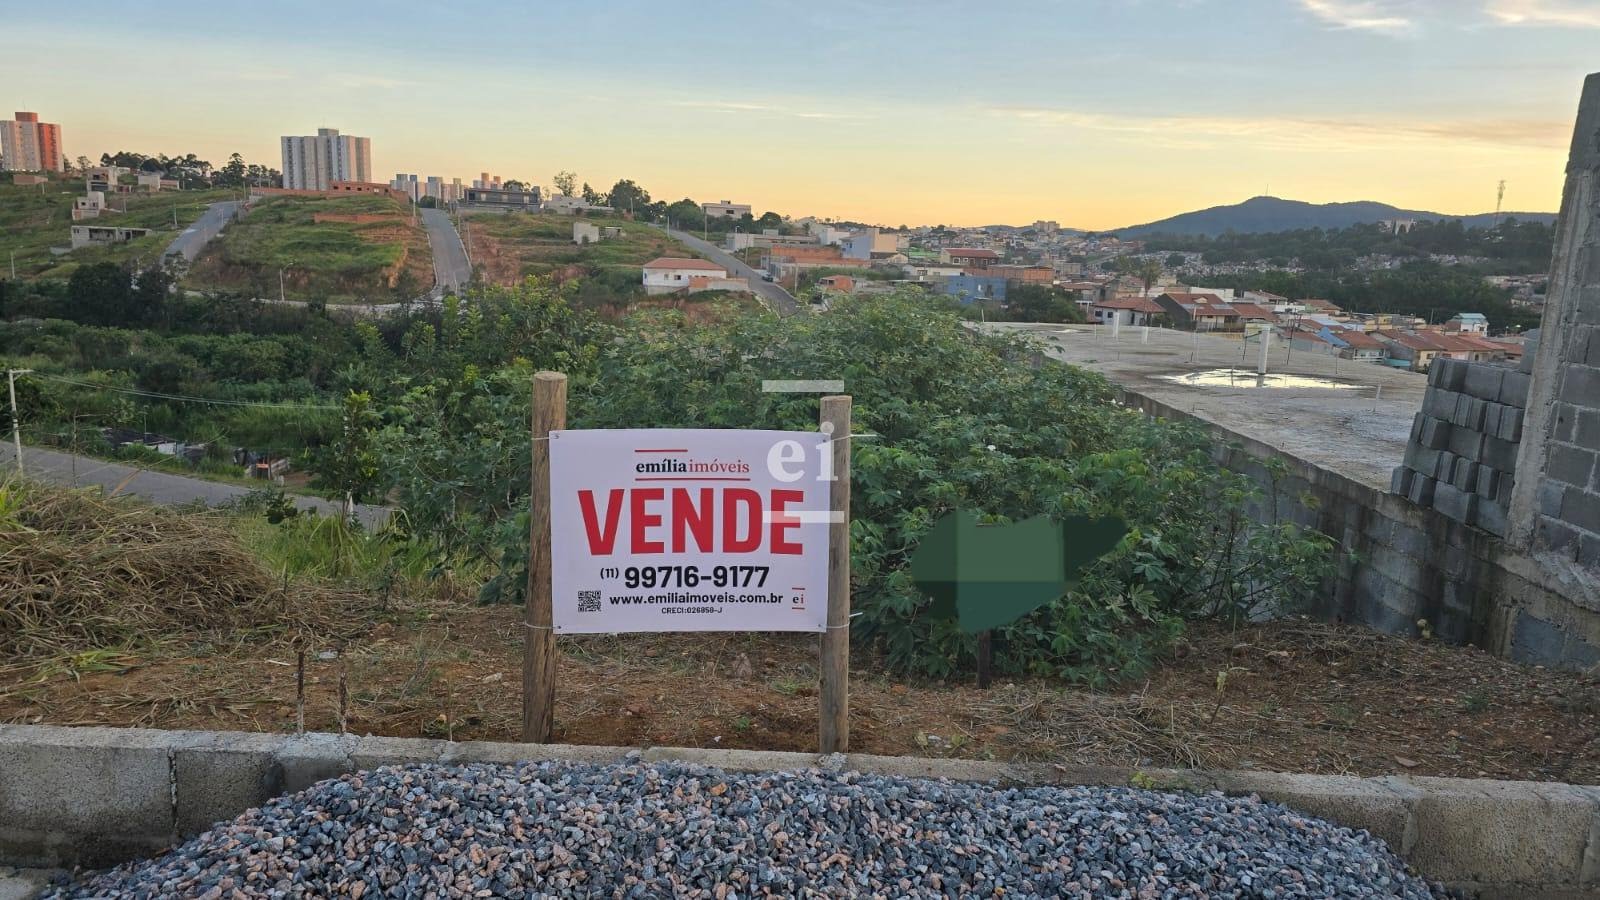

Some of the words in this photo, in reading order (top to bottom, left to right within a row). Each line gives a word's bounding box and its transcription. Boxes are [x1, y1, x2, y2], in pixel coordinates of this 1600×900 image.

[635, 458, 687, 473] emília
[688, 458, 750, 473] imóveis
[577, 488, 804, 556] VENDE
[600, 567, 620, 580] (11)
[624, 565, 770, 588] 99716-9177
[609, 592, 784, 605] www.emiliaimoveis.com.br
[792, 593, 804, 604] ei
